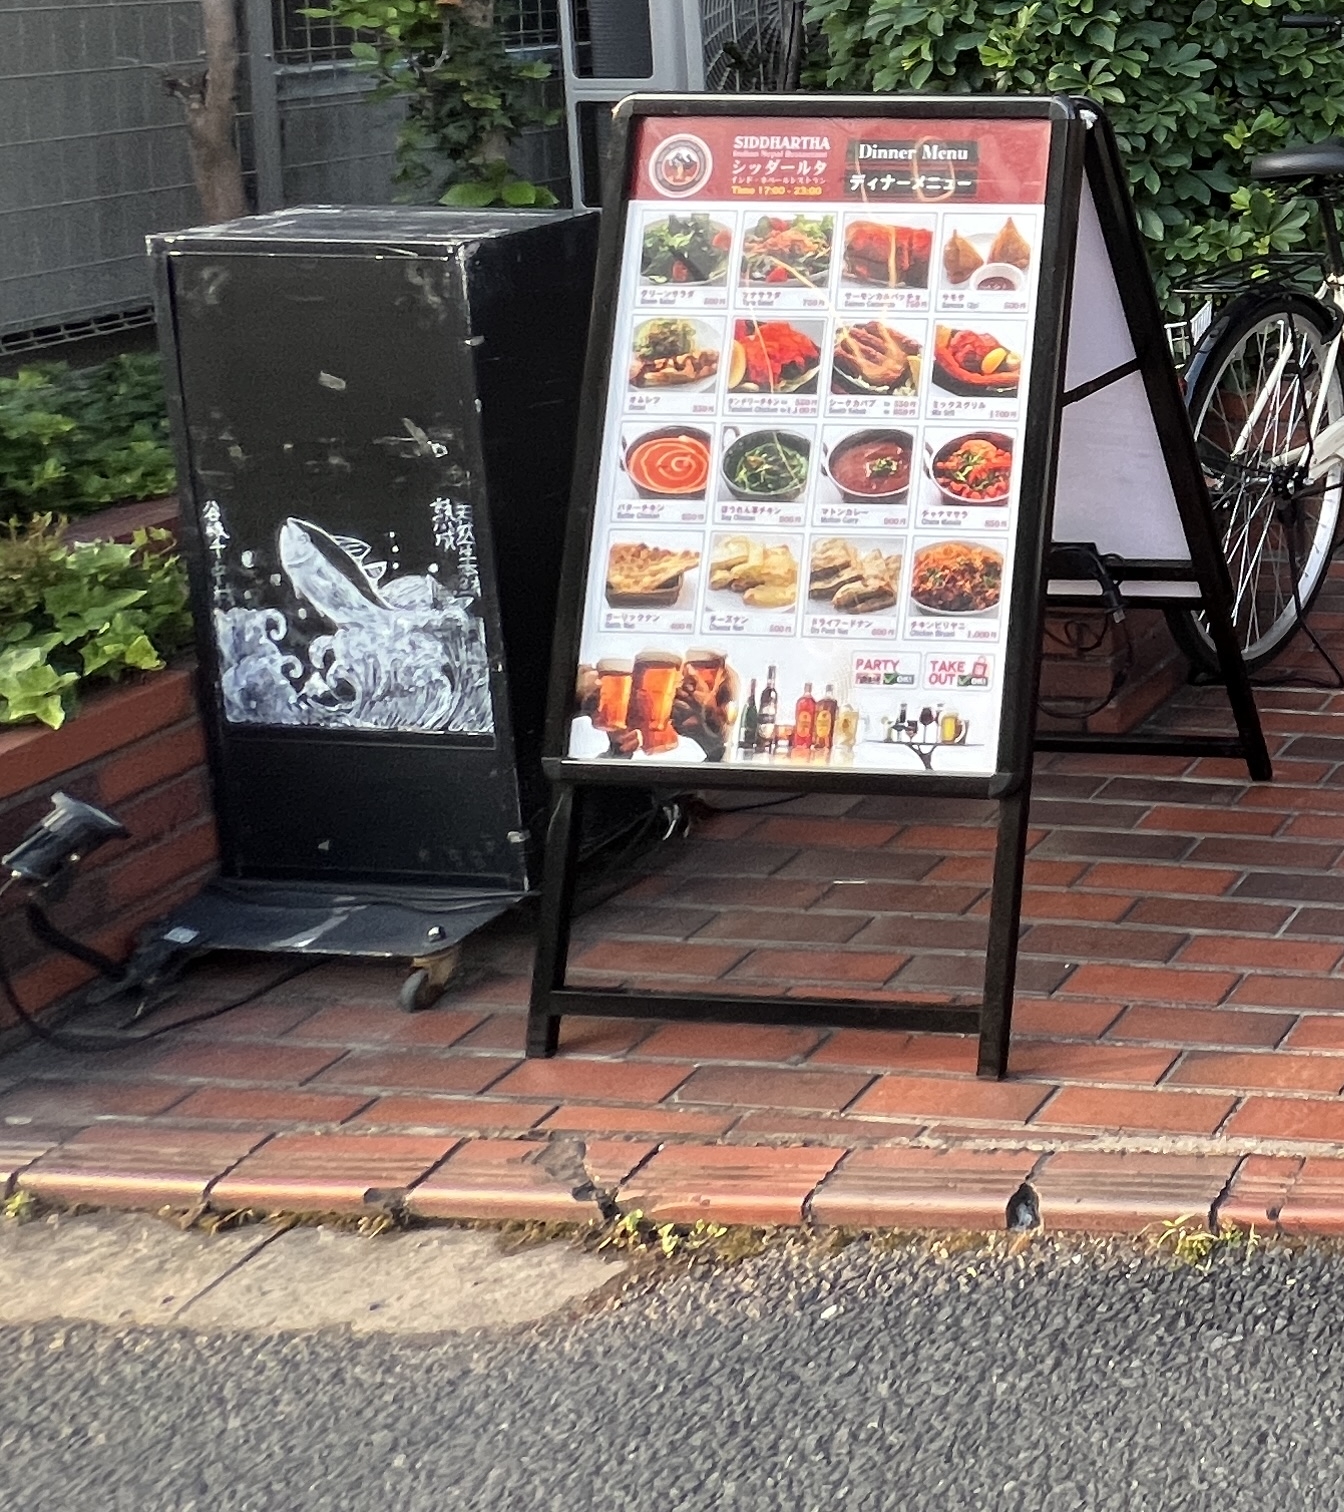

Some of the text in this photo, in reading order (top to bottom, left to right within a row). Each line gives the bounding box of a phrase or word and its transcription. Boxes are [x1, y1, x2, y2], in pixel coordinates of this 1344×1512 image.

[733, 135, 831, 150] SIDDHARTHA
[859, 143, 969, 160] Dinner Menu
[732, 159, 828, 175] シッダールタ
[849, 174, 972, 191] ディナーメニュー
[855, 658, 900, 671] PARTY
[930, 660, 966, 672] TAKE
[928, 674, 956, 685] OUT
